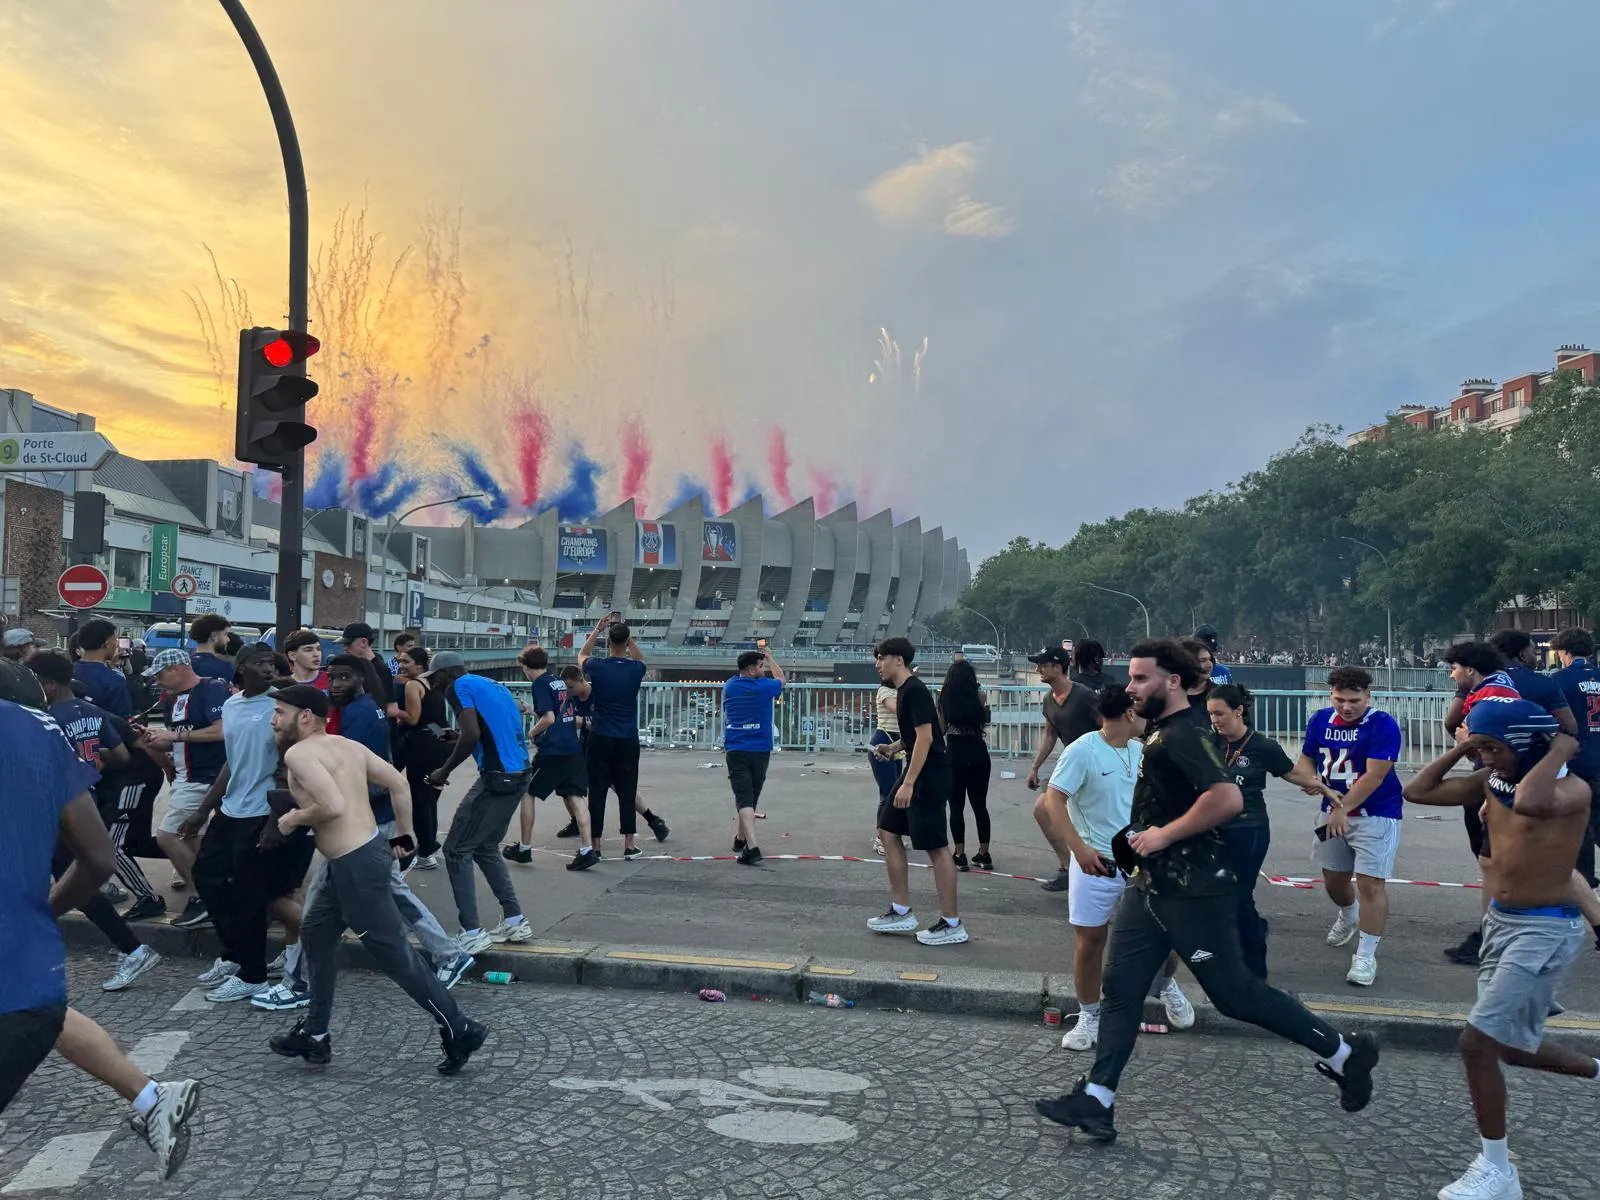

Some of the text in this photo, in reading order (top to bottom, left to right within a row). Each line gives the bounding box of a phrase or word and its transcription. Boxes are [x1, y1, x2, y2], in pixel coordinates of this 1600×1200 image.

[23, 439, 54, 449] Porte
[3, 445, 13, 459] 9
[23, 452, 87, 463] de St-Cloud
[561, 536, 598, 547] CHAMPIONS
[158, 535, 170, 580] Europcar
[563, 546, 596, 557] D'EUROPE
[180, 564, 203, 576] FRANCE
[413, 592, 421, 618] P
[1325, 726, 1360, 742] D.DOUÉ
[1318, 747, 1359, 790] 14
